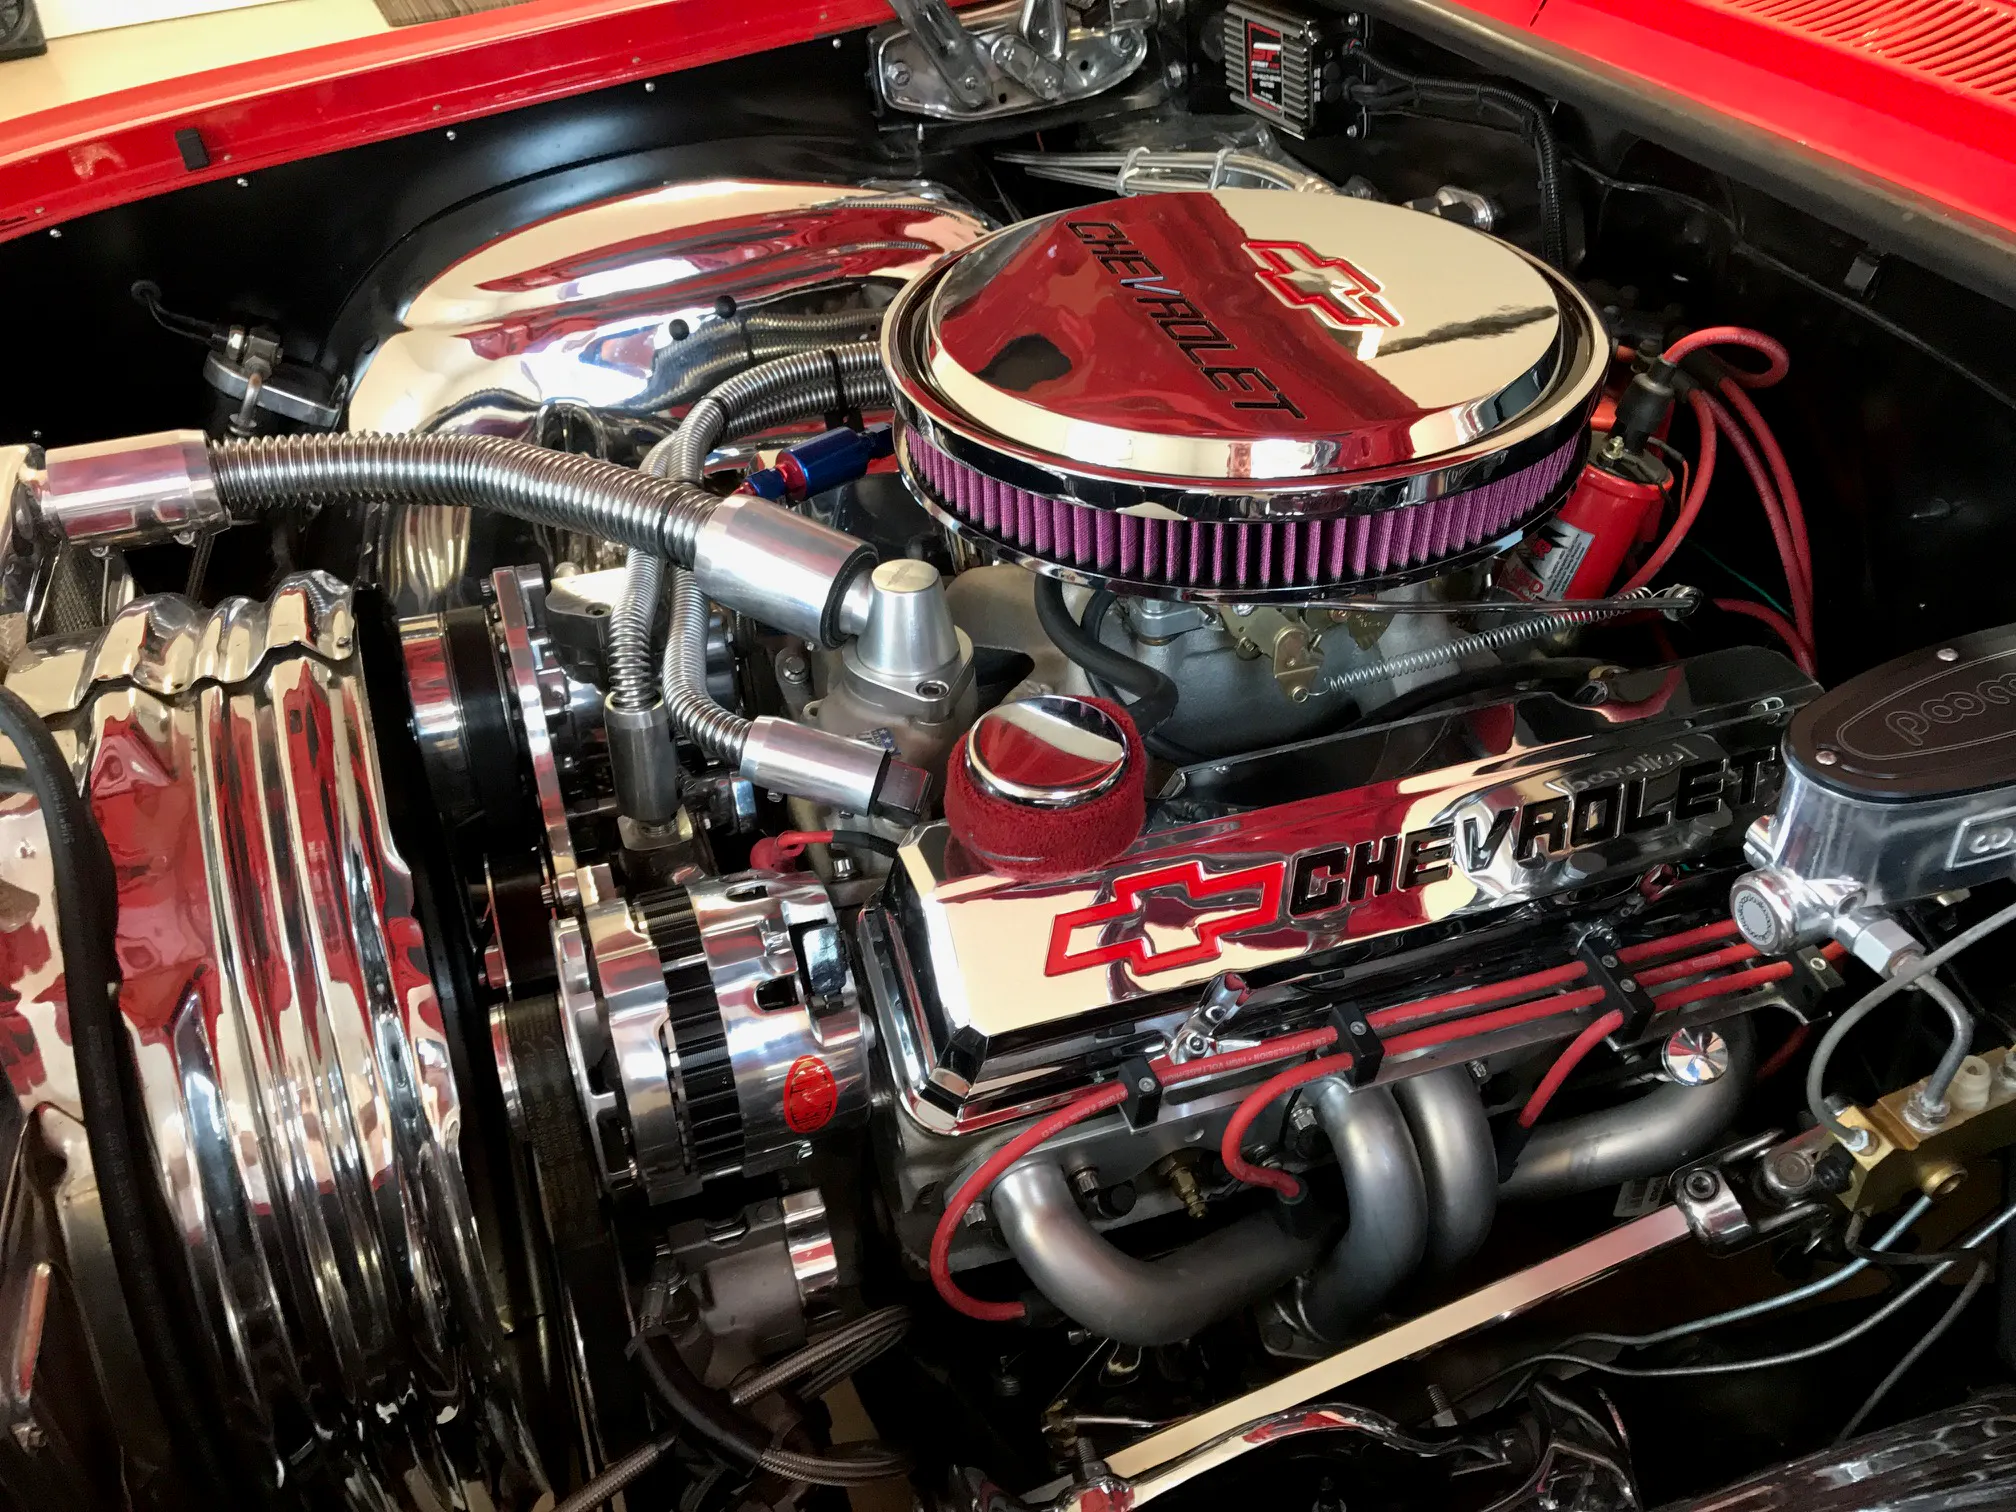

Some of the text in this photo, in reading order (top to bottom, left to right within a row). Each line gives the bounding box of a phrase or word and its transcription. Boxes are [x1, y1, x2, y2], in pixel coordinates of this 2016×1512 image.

[1066, 222, 1307, 420] CHEVROLET
[1885, 672, 2016, 746] wood
[1290, 746, 1776, 917] CHEVROLET
